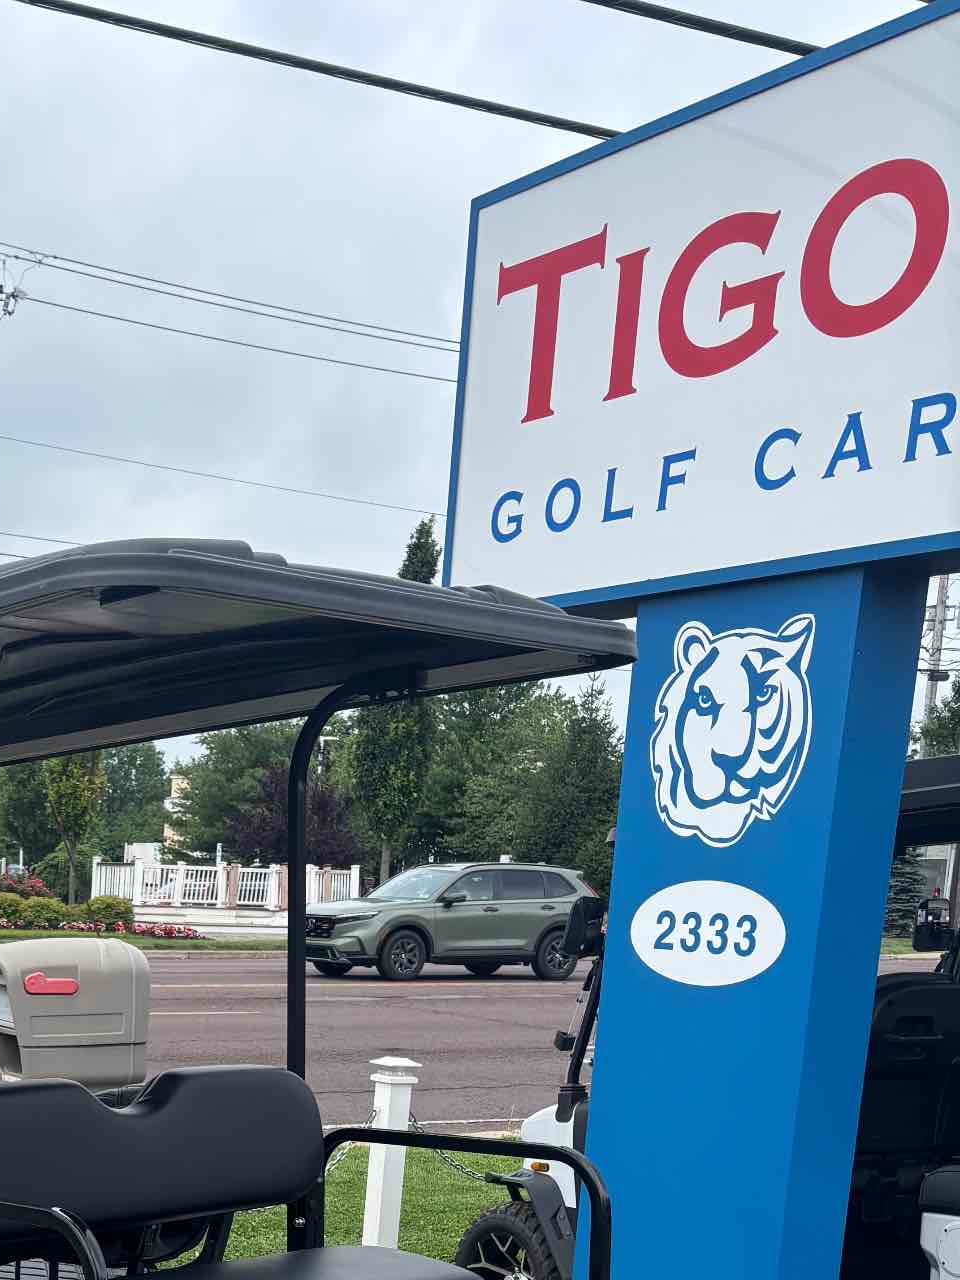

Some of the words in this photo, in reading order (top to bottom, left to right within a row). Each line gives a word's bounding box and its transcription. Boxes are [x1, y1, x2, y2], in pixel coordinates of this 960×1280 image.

[497, 158, 950, 424] TIGO
[490, 448, 697, 544] GOLF
[753, 391, 958, 493] CAR
[653, 910, 758, 957] 2333
